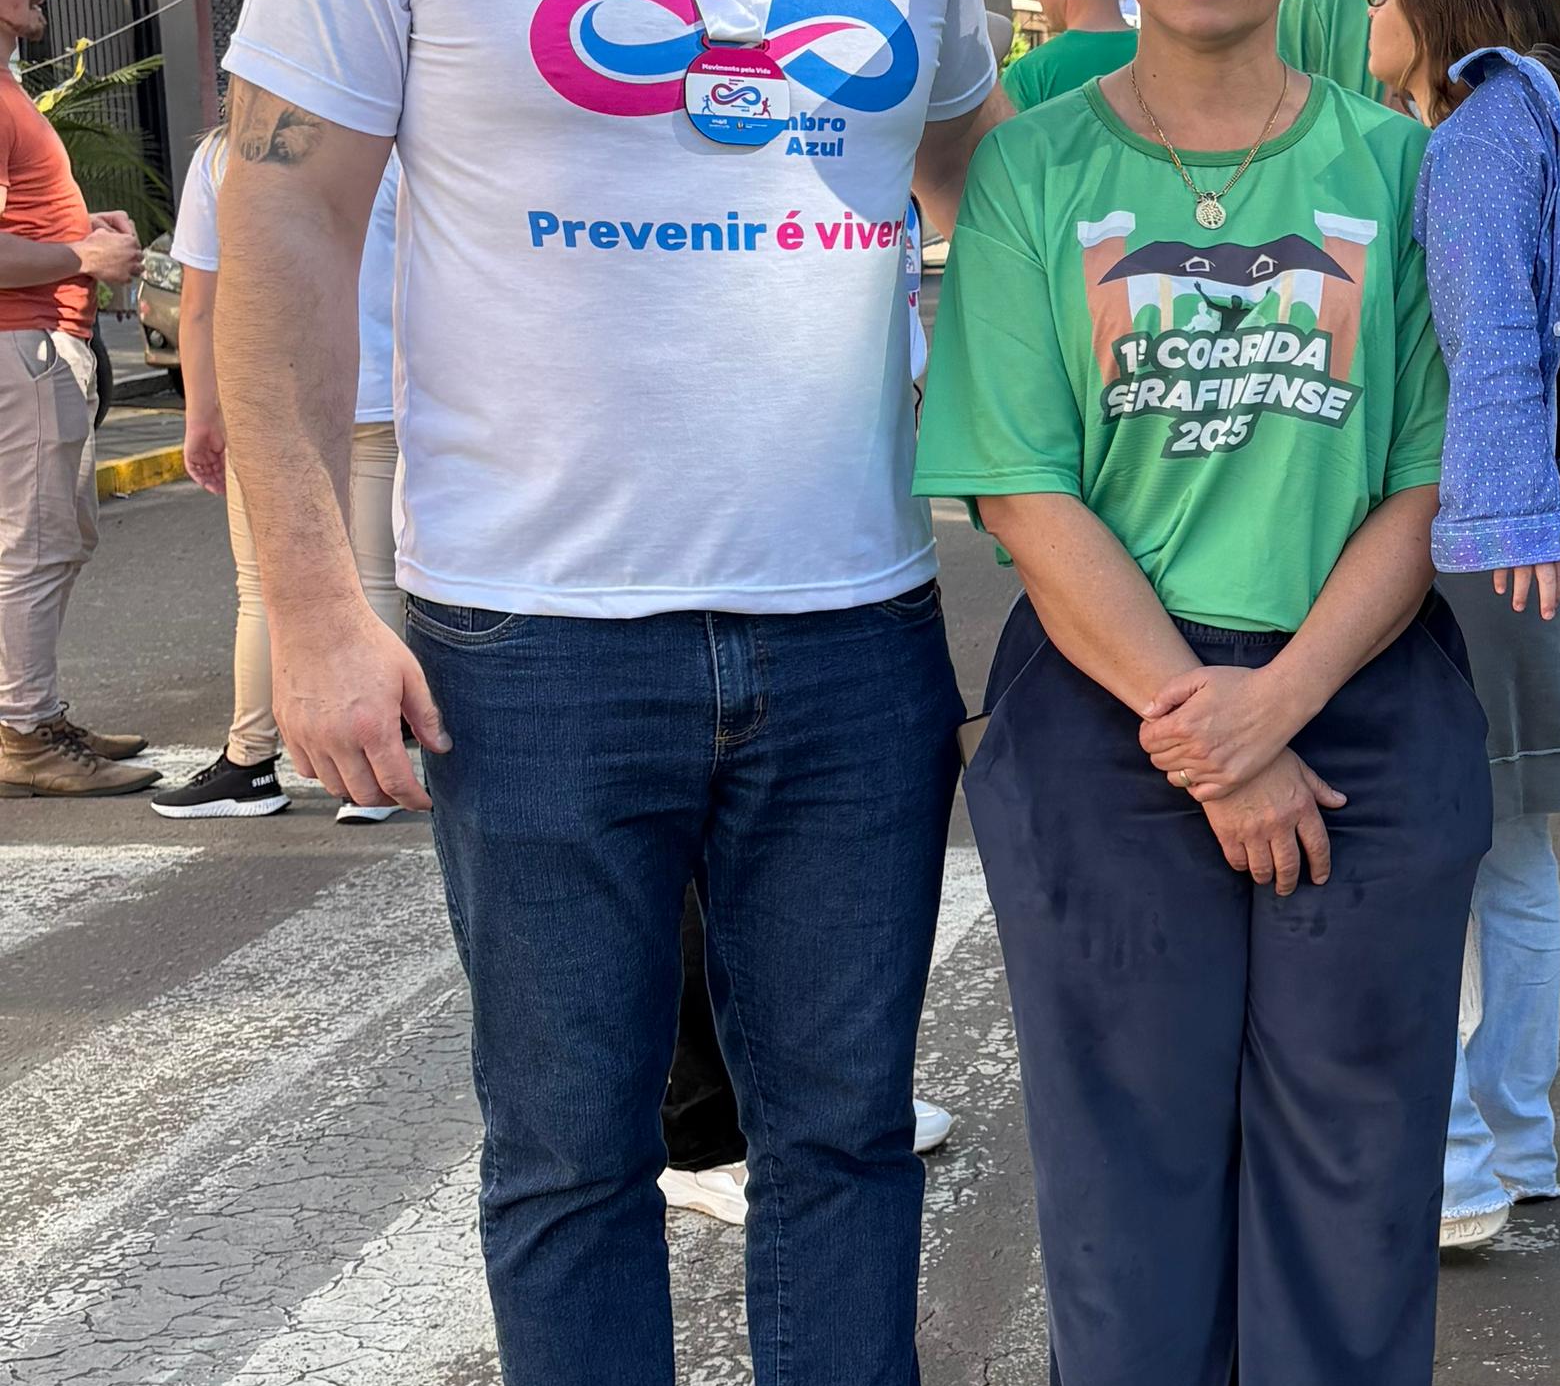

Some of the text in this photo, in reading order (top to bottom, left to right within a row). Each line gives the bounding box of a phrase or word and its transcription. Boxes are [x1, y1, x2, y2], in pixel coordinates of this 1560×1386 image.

[785, 136, 844, 157] Azul
[527, 211, 767, 252] Prevenir
[776, 210, 804, 251] é
